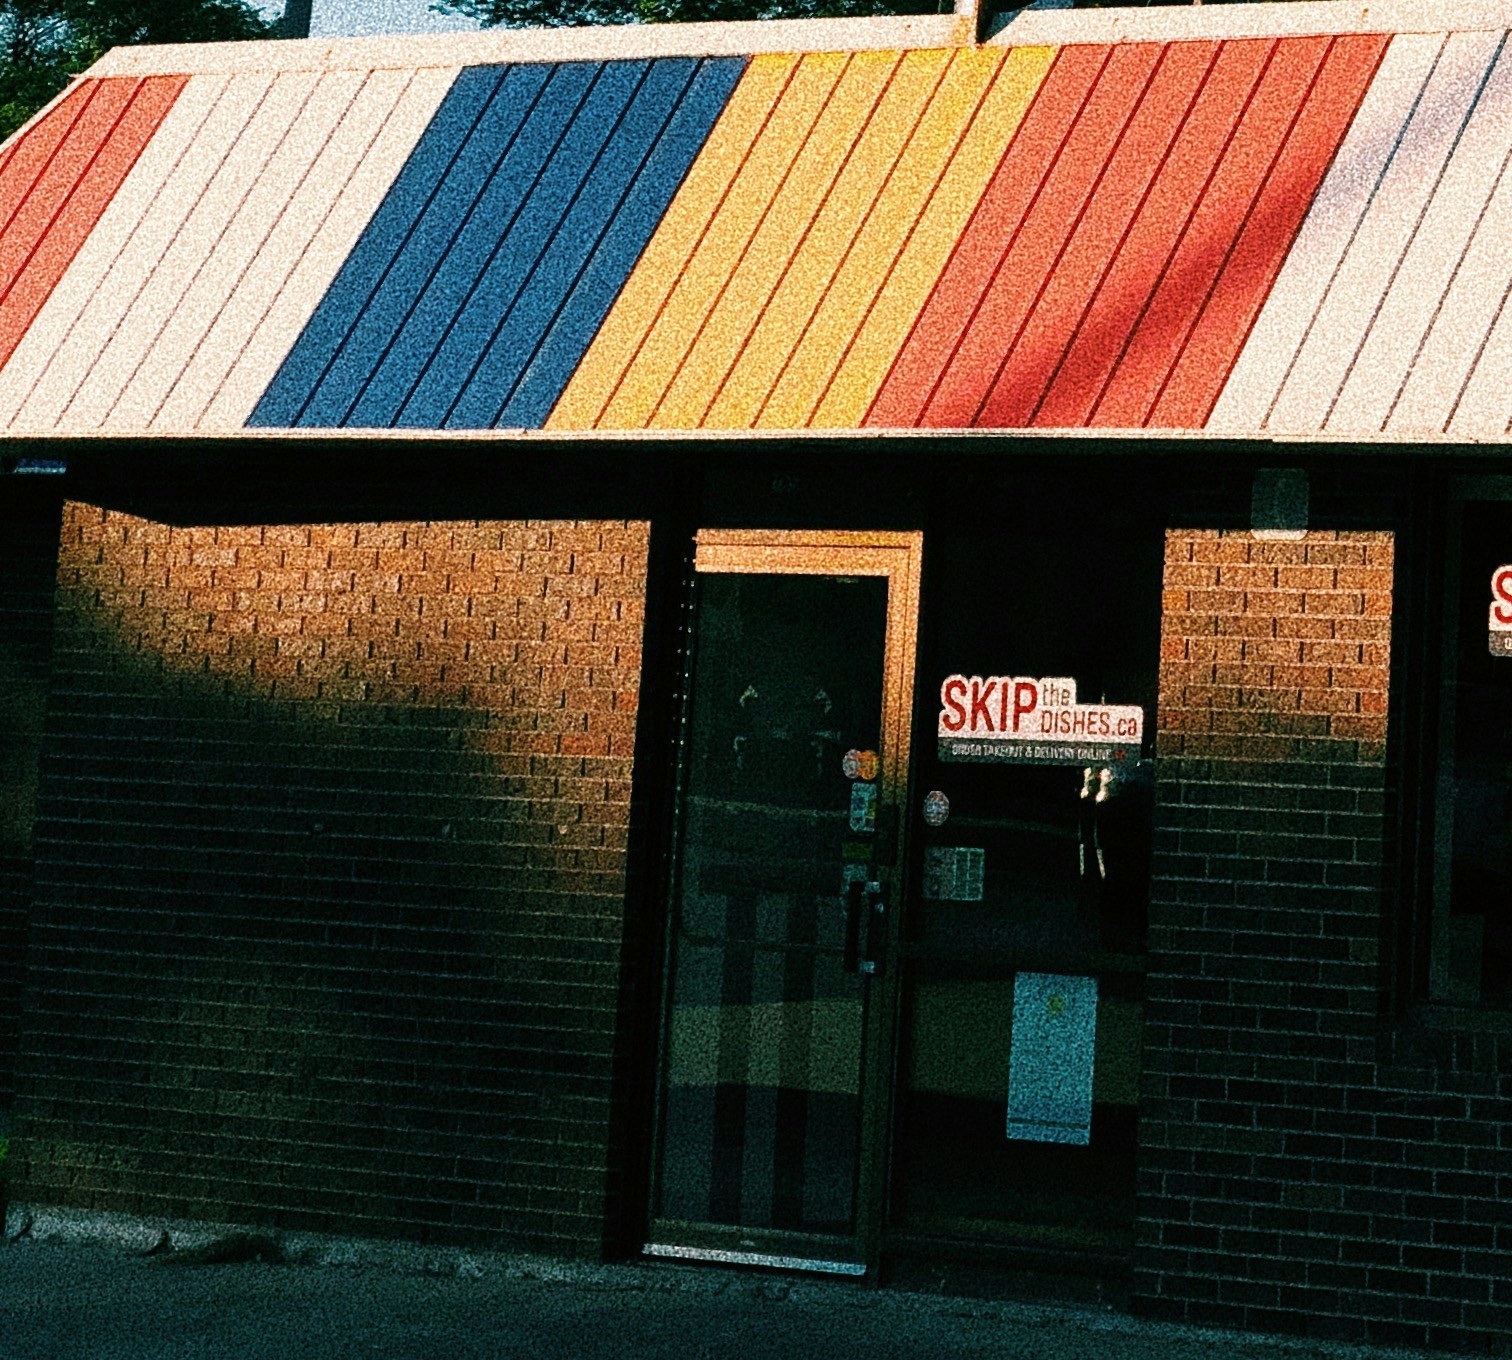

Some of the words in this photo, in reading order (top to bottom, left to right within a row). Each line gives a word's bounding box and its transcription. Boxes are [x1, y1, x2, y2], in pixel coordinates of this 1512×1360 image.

[942, 679, 1038, 732] SKIP
[1042, 683, 1070, 706] the
[1041, 710, 1138, 737] DISHES.ca
